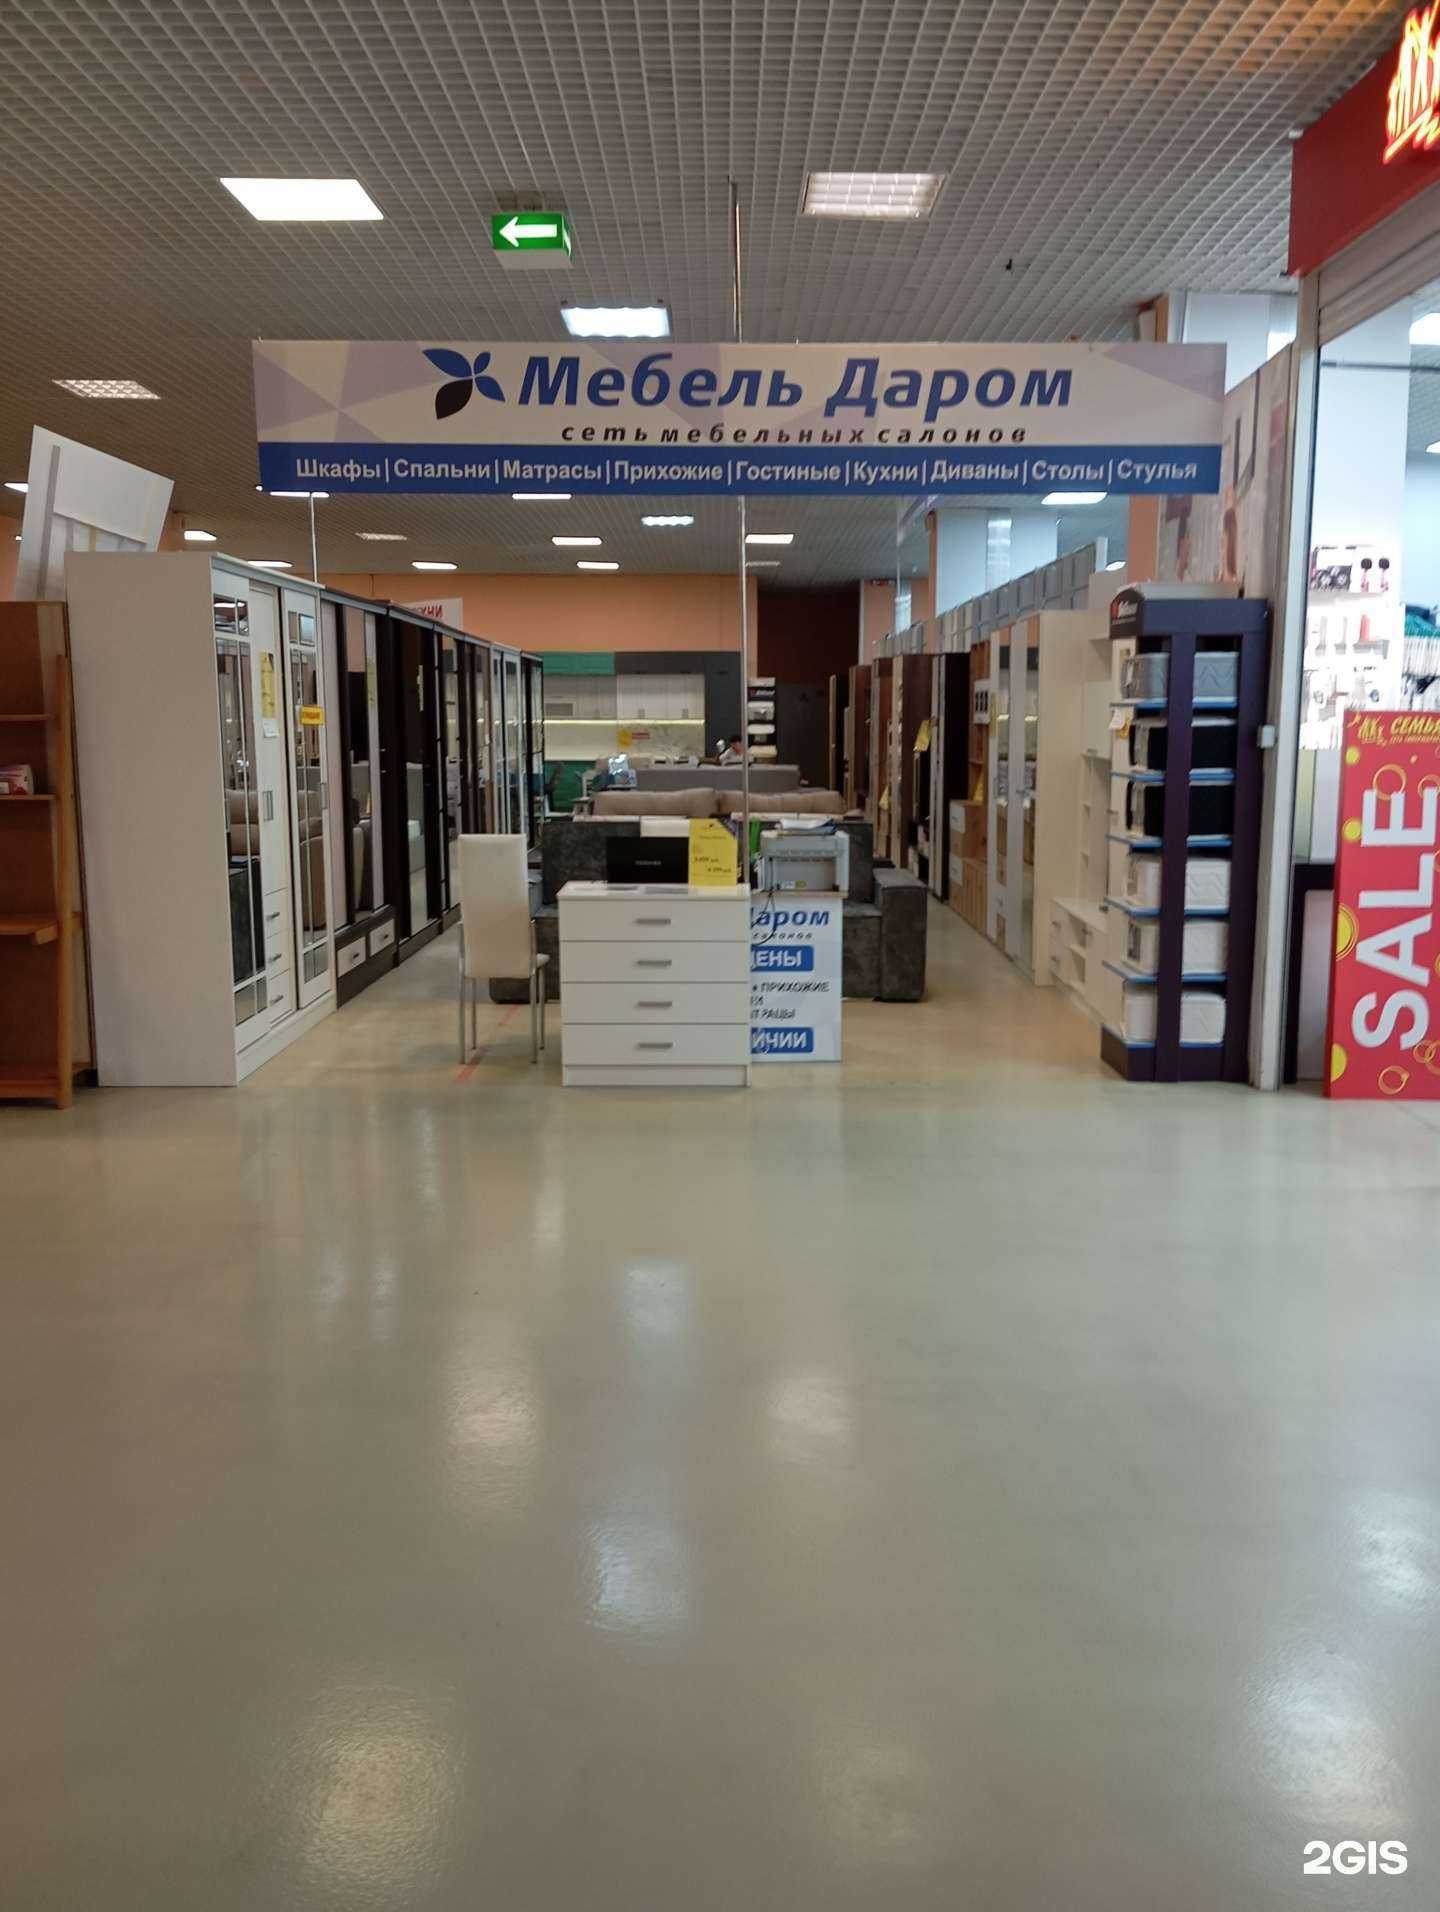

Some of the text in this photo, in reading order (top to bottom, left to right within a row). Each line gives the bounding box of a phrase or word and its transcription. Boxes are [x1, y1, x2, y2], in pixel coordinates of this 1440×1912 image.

[518, 352, 1073, 424] Мебель Даром
[561, 422, 1027, 444] сеть мебельных салонов
[296, 458, 1197, 487] Шкафы Спальни Матрасы Прихожие Гостиные Кухни Диваны Столы Стулья
[751, 907, 830, 934] аром
[1352, 786, 1439, 1051] SALE
[752, 1031, 807, 1048] ИЧИИ
